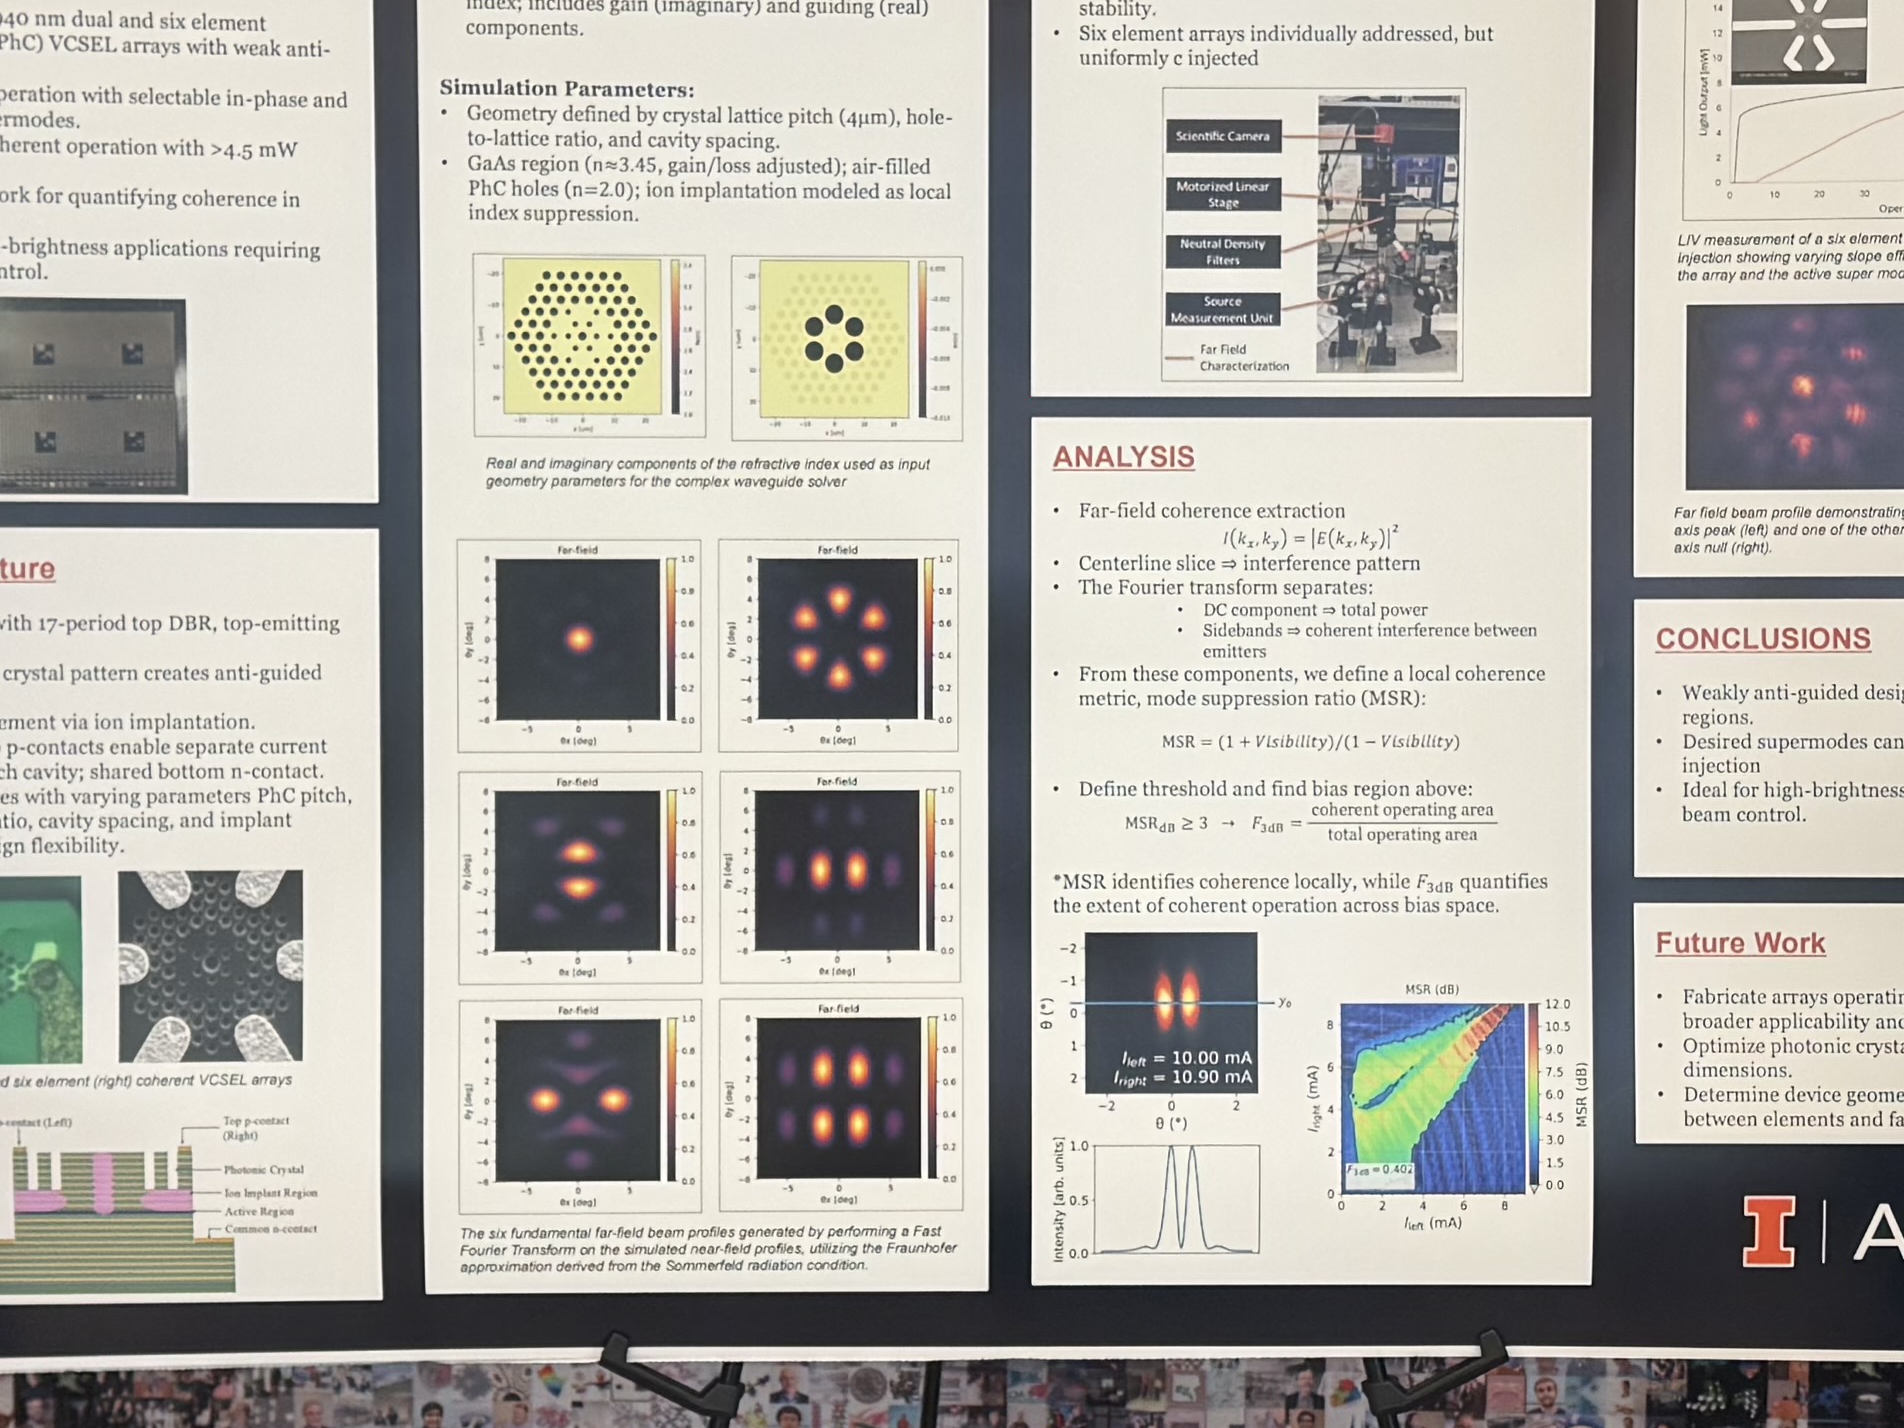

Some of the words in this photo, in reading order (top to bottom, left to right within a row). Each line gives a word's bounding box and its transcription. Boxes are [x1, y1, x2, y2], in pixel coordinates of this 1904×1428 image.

[34, 12, 66, 29] nm
[71, 8, 114, 29] dual
[118, 10, 155, 30] and
[159, 10, 187, 31] six
[190, 11, 267, 34] element
[439, 76, 558, 98] Simulation
[565, 79, 694, 99] Parameters:
[1175, 129, 1226, 143] Scientific
[1227, 129, 1271, 143] Camera
[1176, 179, 1234, 193] Motorized
[1235, 180, 1270, 193] Linear
[1208, 196, 1240, 209] Stage
[1200, 342, 1218, 355] Far
[1220, 342, 1247, 356] Field
[1199, 359, 1290, 373] Characterization
[1052, 443, 1195, 468] ANALYSIS
[1079, 500, 1156, 520] Far-field
[1161, 500, 1252, 520] coherence
[1256, 500, 1346, 520] extraction
[1656, 626, 1871, 652] CONCLUSIONS
[61, 712, 89, 732] via
[94, 712, 124, 732] ion
[129, 711, 256, 736] implantation.
[1683, 731, 1752, 751] Desired
[1756, 731, 1868, 755] supermodes
[1873, 736, 1904, 751] can
[1682, 758, 1761, 779] injection
[1656, 930, 1745, 955] Future
[1754, 930, 1827, 955] Work
[1405, 982, 1432, 996] MSR
[1434, 982, 1460, 997] (dB)
[1683, 986, 1767, 1006] Fabricate
[1771, 992, 1828, 1010] arrays
[12, 1074, 33, 1089] six
[35, 1074, 91, 1089] element
[93, 1073, 133, 1092] (right)
[135, 1073, 196, 1088] coherent
[199, 1072, 248, 1088] VCSEL
[251, 1074, 293, 1090] arrays
